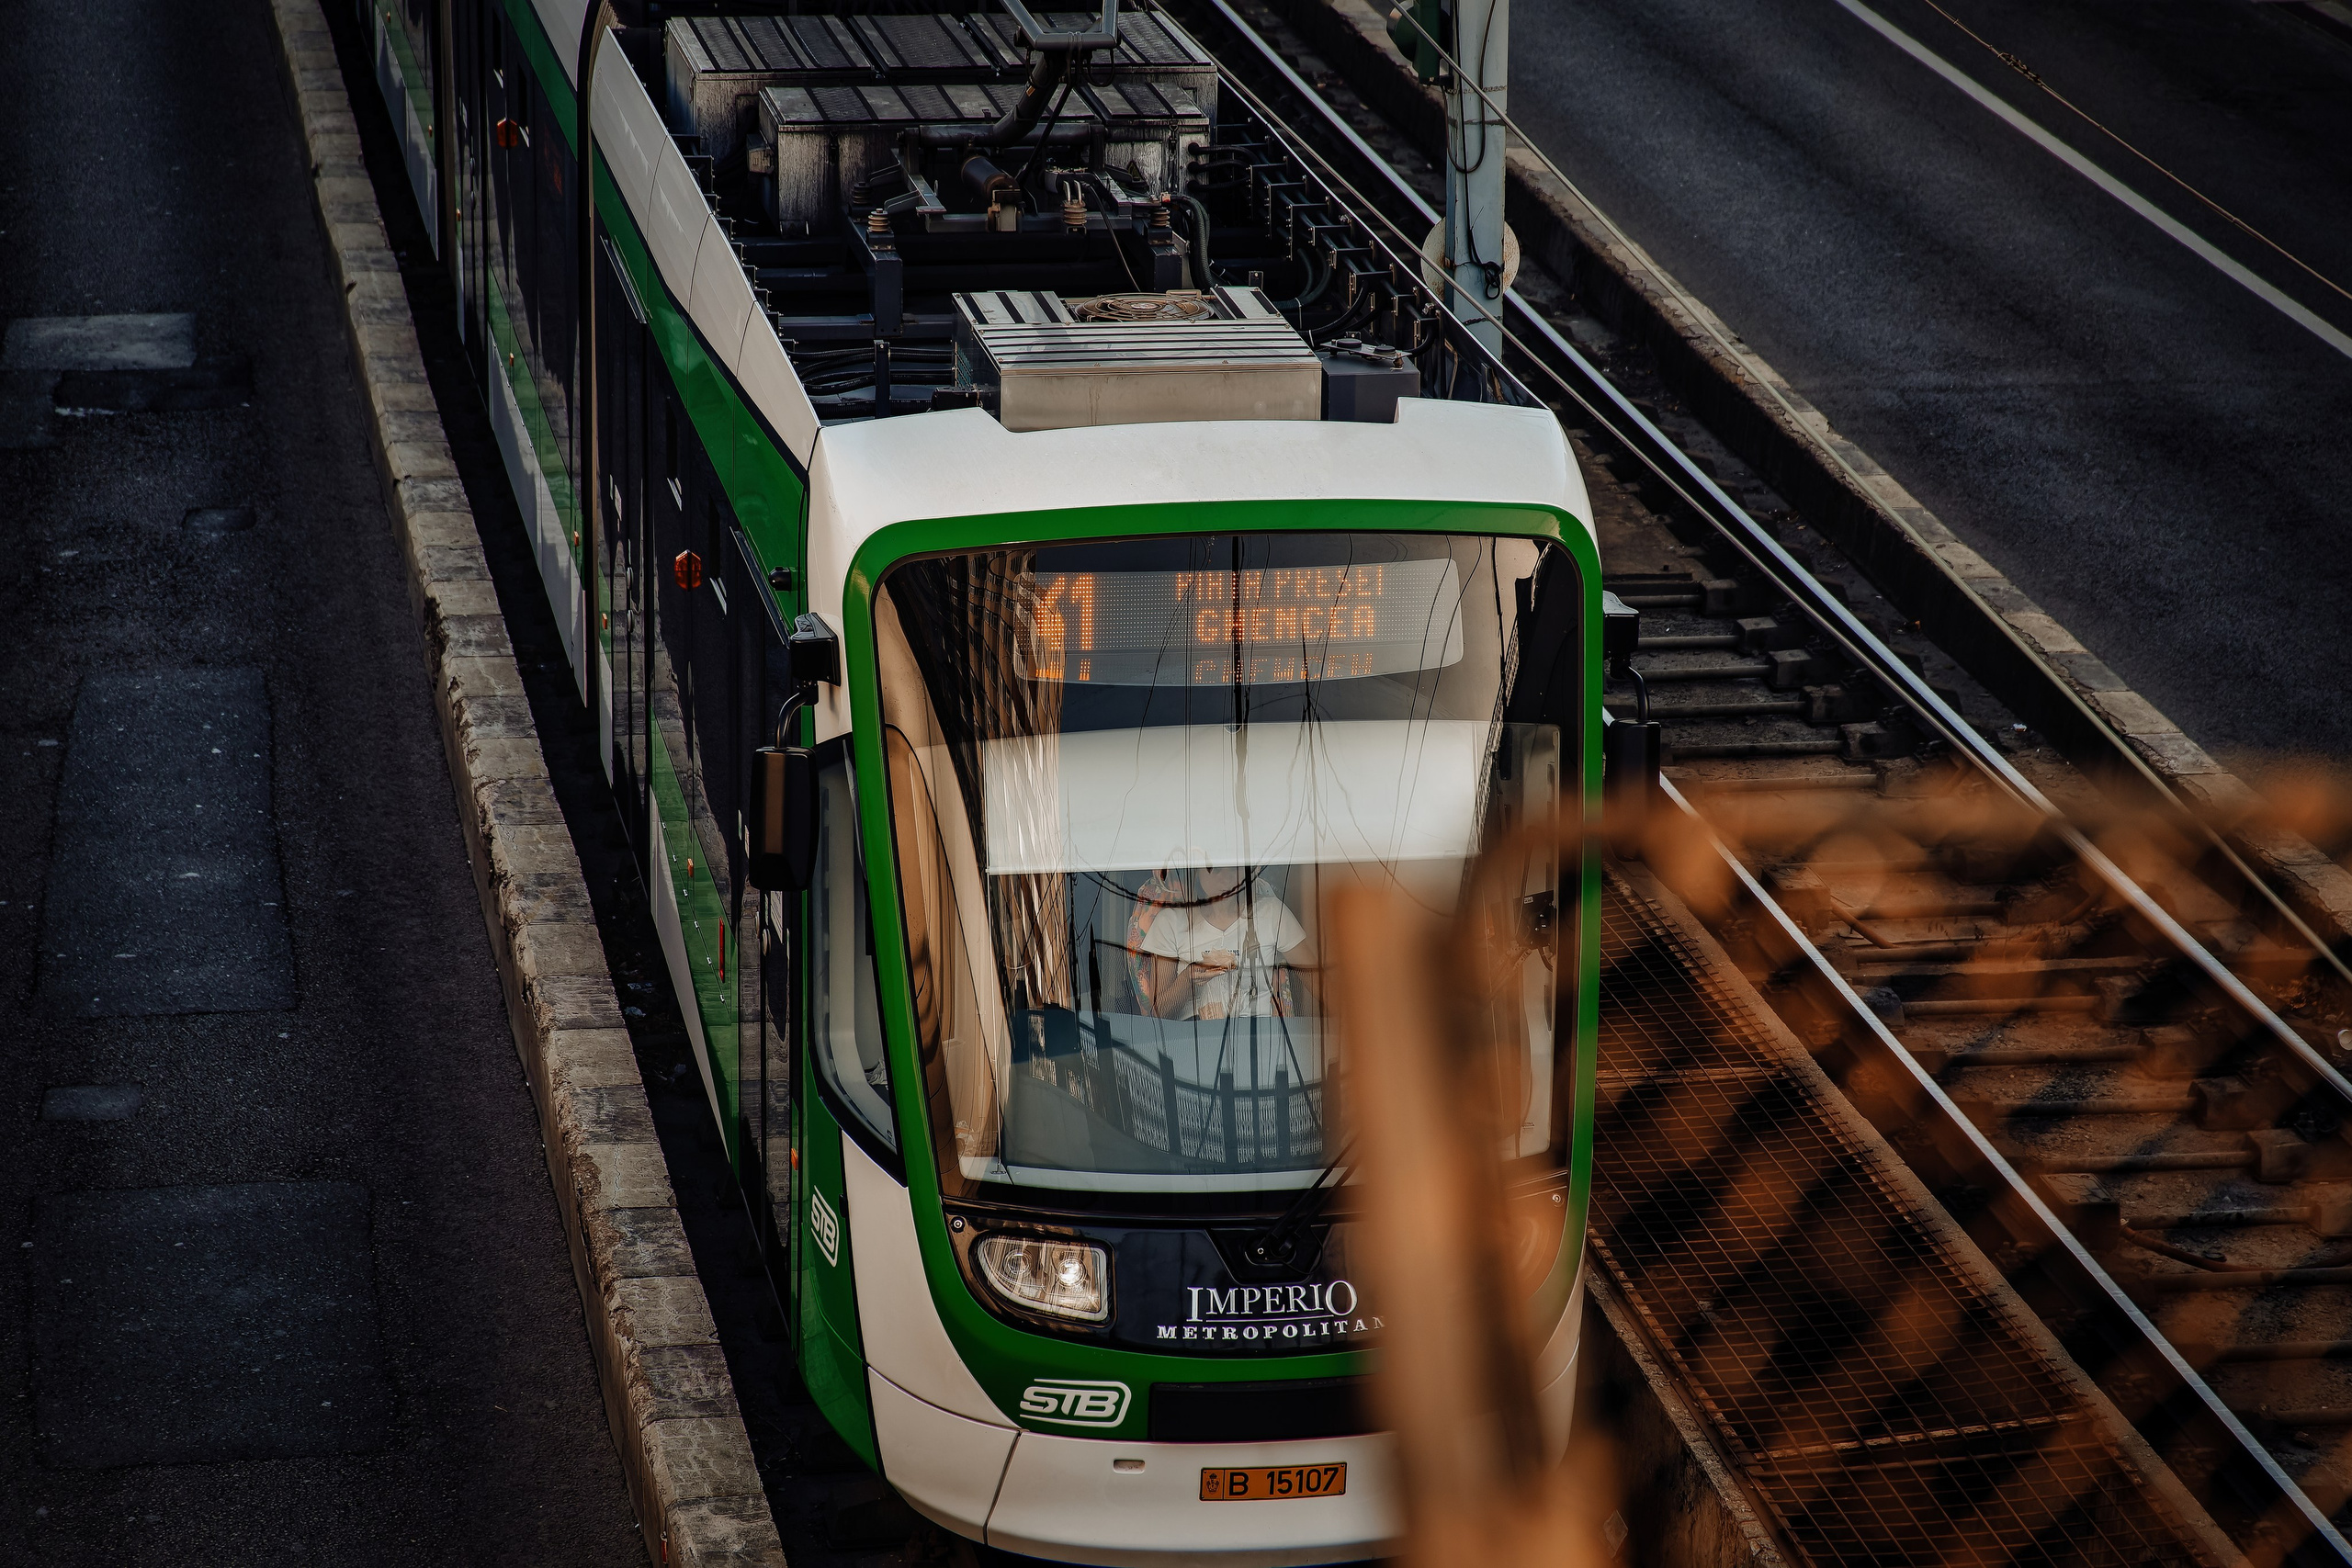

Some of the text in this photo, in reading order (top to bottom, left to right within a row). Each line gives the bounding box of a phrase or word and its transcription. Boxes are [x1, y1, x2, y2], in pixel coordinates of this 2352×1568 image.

[1037, 576, 1092, 650] 41
[1197, 605, 1374, 641] GHENCEA
[810, 1193, 837, 1254] STB
[1186, 1280, 1358, 1323] IMPERIO
[1019, 1385, 1120, 1418] STB
[1228, 1467, 1340, 1496] B 15107
